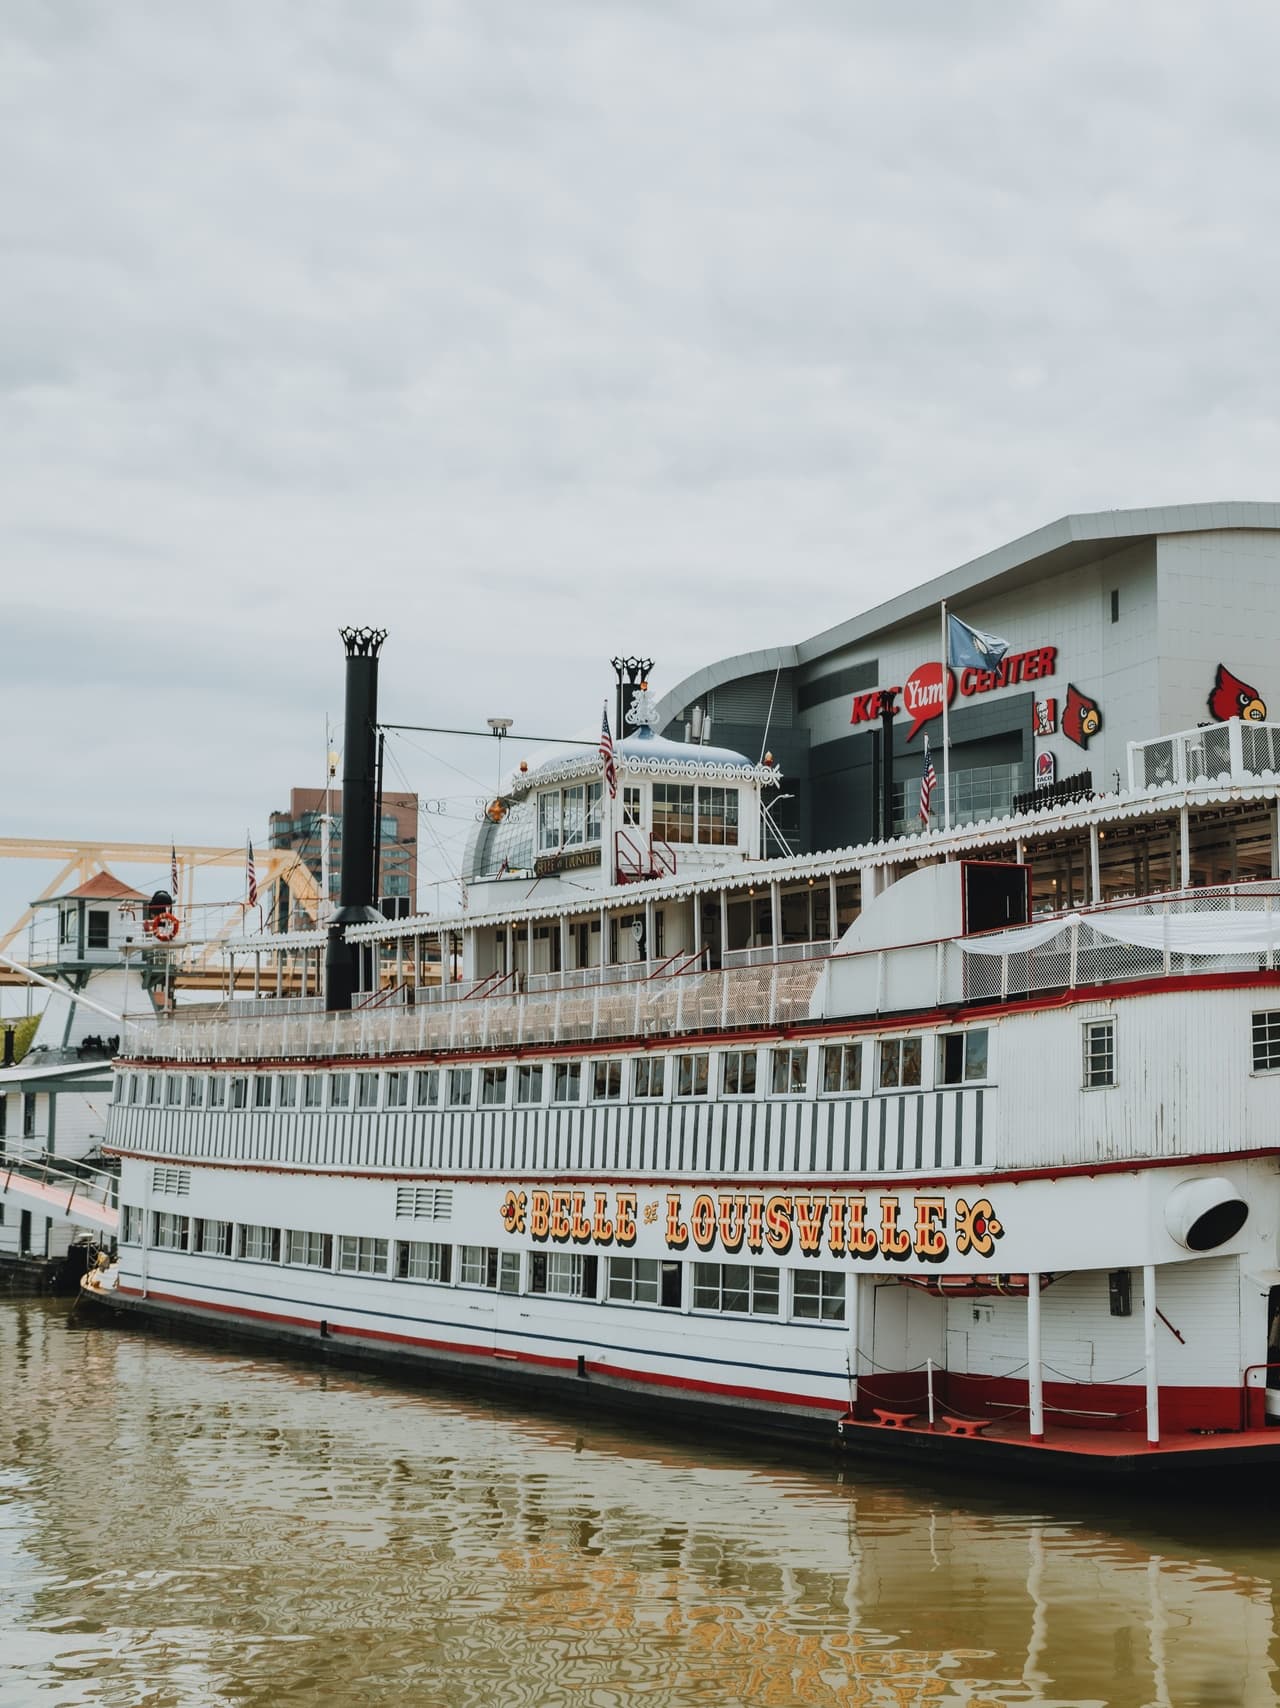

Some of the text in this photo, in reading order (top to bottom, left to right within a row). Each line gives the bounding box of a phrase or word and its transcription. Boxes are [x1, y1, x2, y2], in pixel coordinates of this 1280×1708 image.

[961, 646, 1057, 696] CENTER
[1036, 775, 1053, 783] TACO
[530, 1189, 640, 1247] BELLE
[665, 1192, 950, 1263] LOUISVILLE
[837, 1420, 844, 1433] 5
